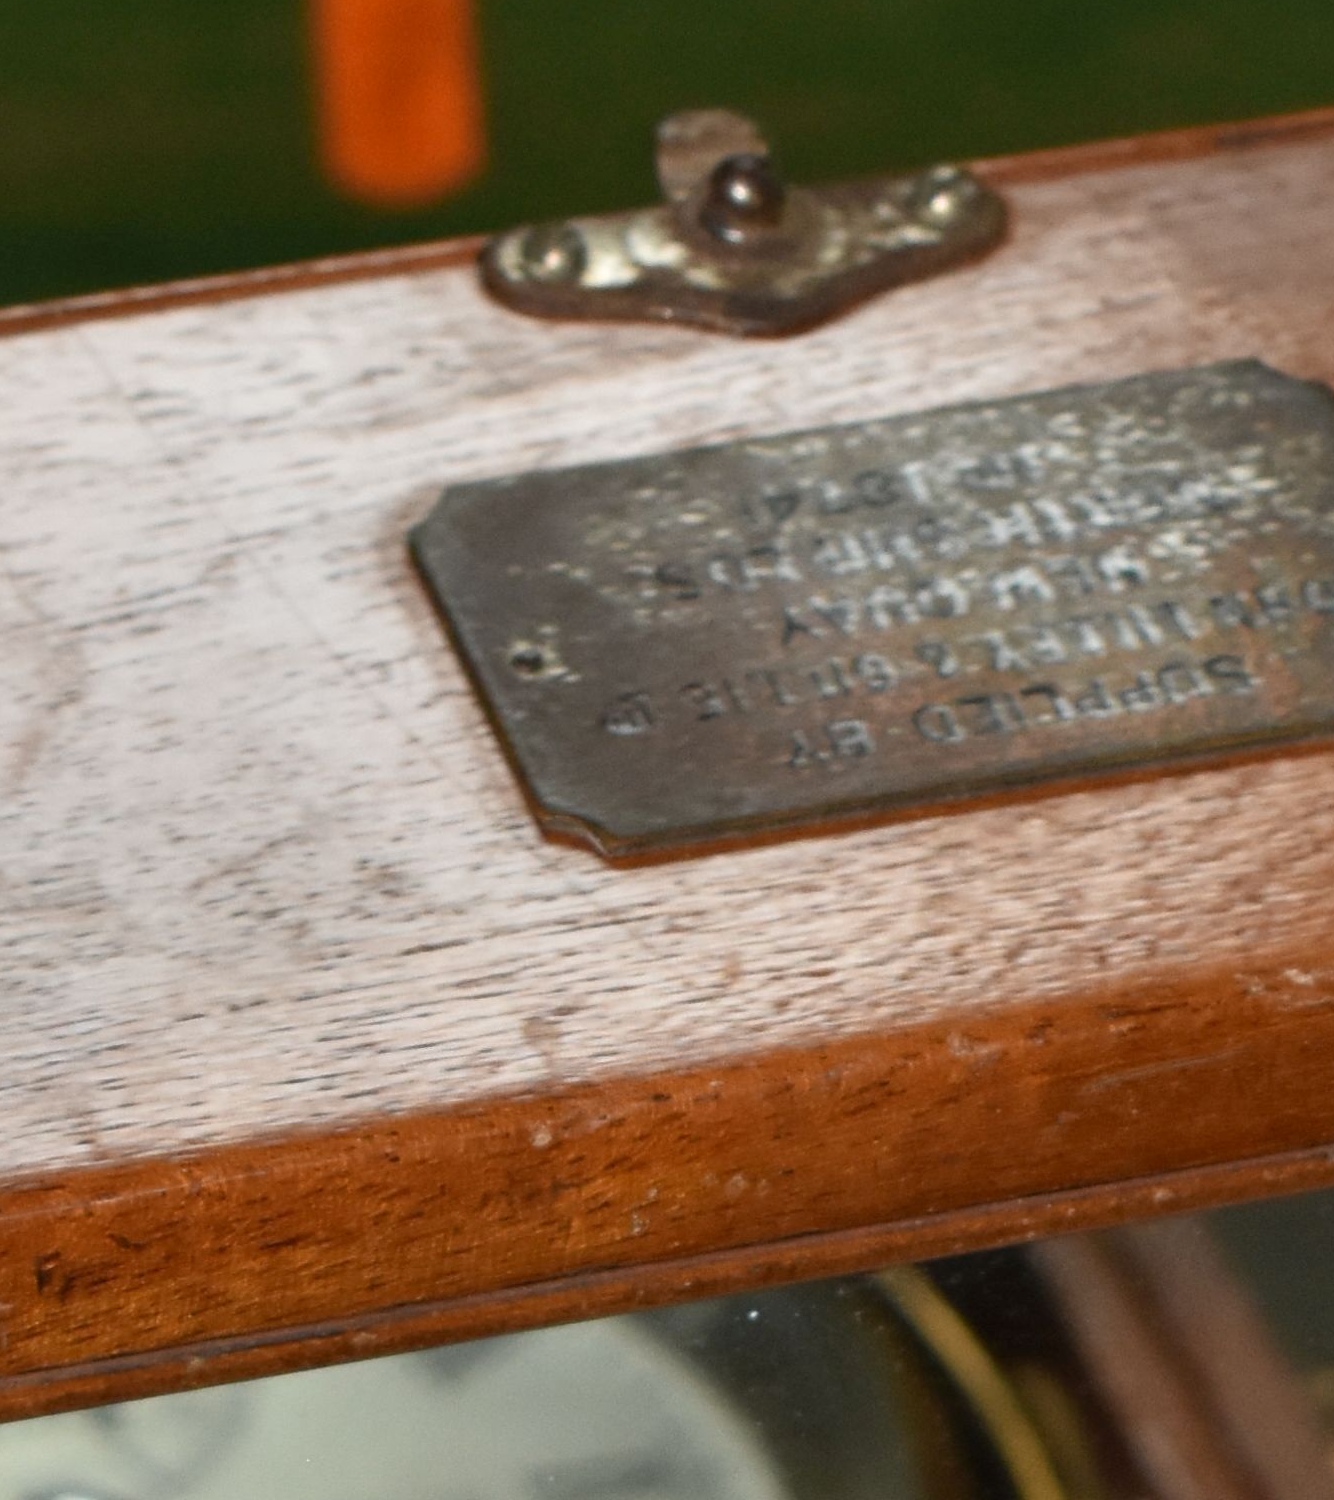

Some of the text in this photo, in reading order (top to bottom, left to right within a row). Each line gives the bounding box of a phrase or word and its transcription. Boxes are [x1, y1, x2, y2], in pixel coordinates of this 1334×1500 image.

[763, 545, 1153, 648] NEW QUAY
[772, 654, 1260, 770] SUPPLIED BY
